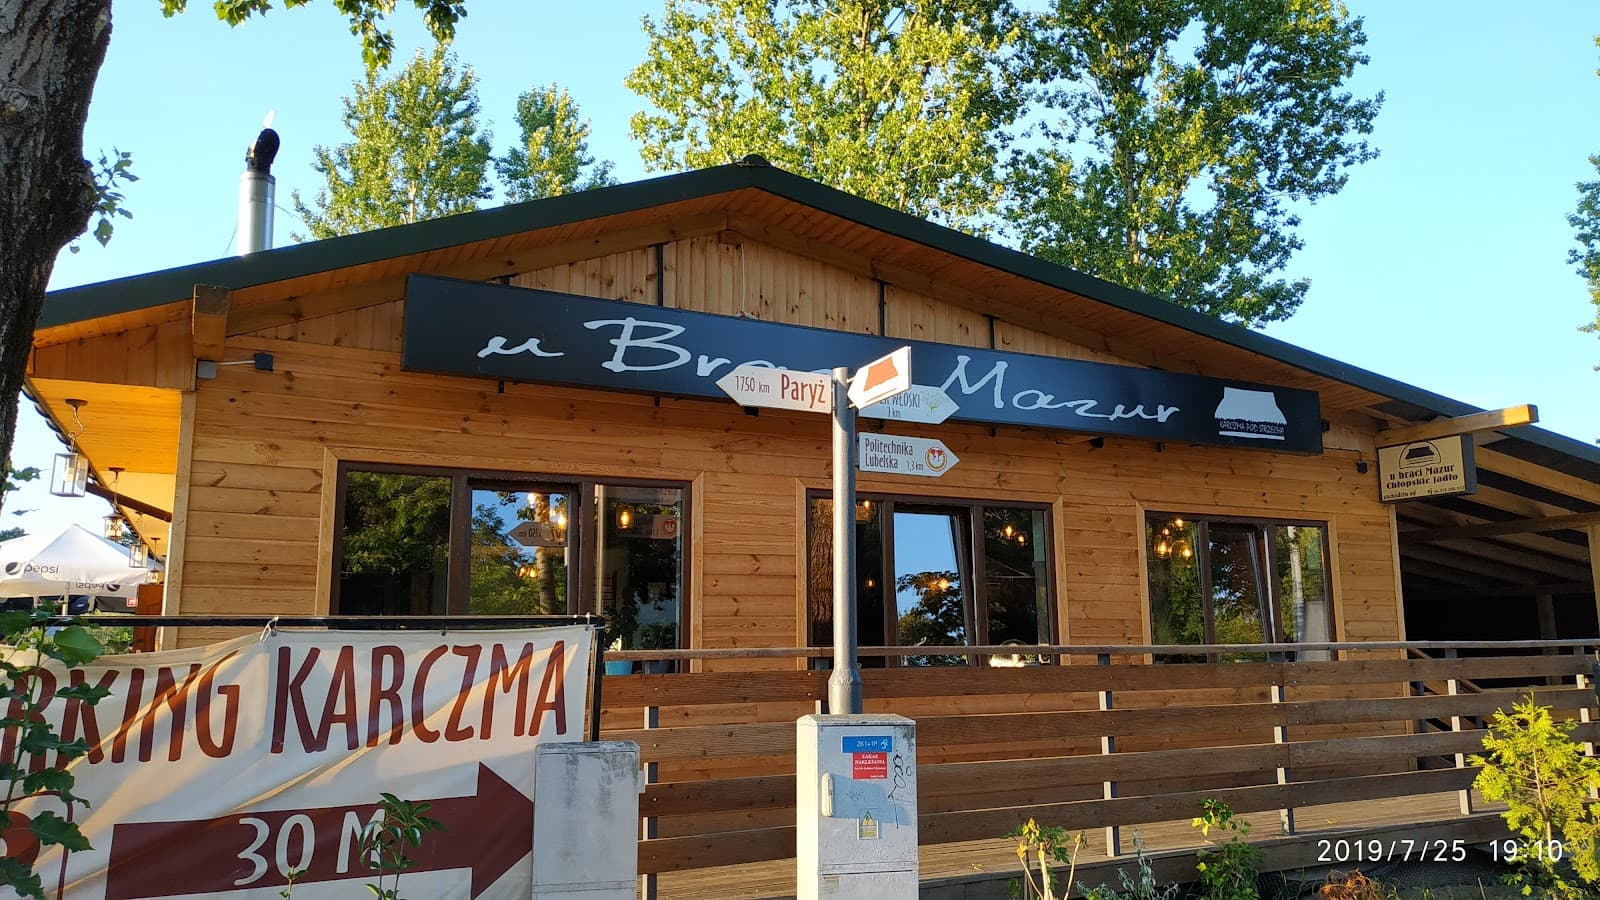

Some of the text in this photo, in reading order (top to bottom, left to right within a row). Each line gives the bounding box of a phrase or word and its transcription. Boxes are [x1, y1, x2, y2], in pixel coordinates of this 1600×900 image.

[735, 373, 826, 409] 1750 km Paryż
[940, 355, 1180, 423] Mazur
[864, 437, 913, 456] Politechnika
[865, 452, 924, 472] Lubelska 1,3 km
[1398, 468, 1423, 480] braci
[1425, 464, 1455, 476] Mazur
[23, 562, 59, 574] pepsi
[270, 640, 567, 754] KARCZMA
[233, 808, 386, 886] 30 M
